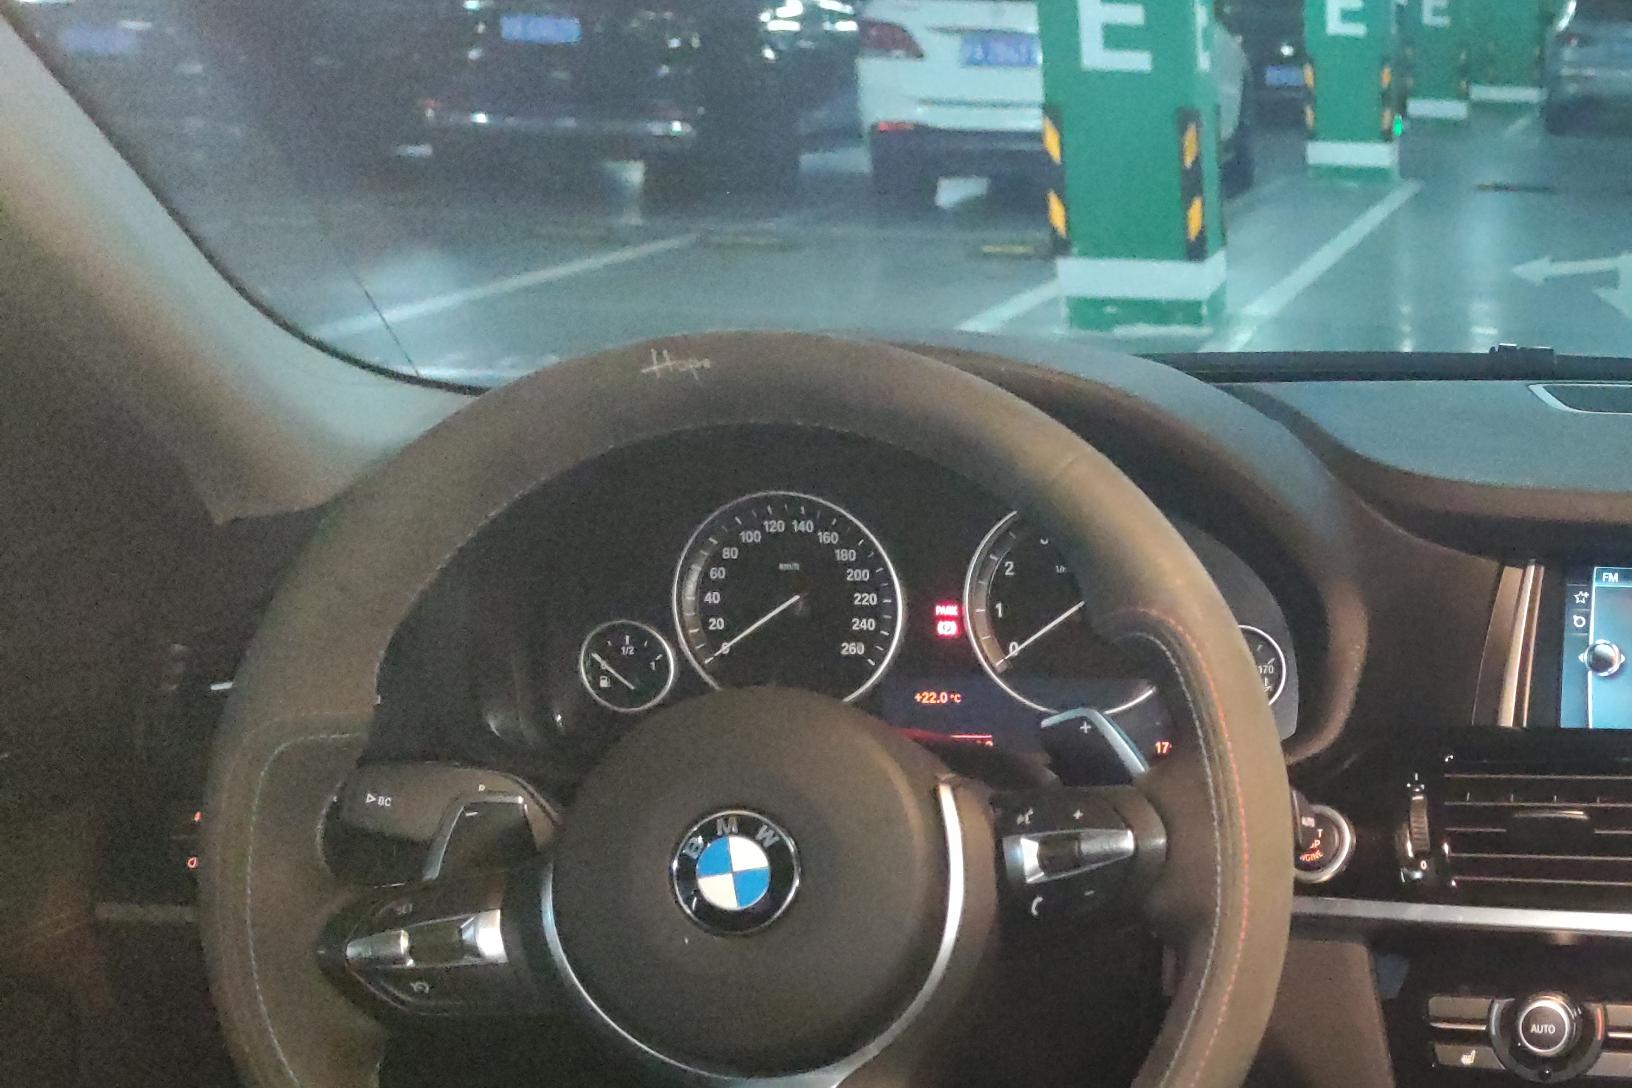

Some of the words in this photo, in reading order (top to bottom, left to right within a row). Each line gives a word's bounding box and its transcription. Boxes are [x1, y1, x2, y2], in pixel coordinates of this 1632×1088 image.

[763, 520, 785, 532] 120
[792, 520, 814, 532] 140
[740, 530, 761, 543] 100
[818, 531, 839, 544] 160
[722, 547, 738, 559] 80
[835, 549, 856, 561] 180
[709, 567, 725, 579] 60
[1004, 561, 1015, 575] 2
[846, 569, 869, 581] 200
[1602, 573, 1619, 583] FM
[704, 592, 720, 604] 40
[854, 593, 877, 606] 220
[995, 602, 1003, 617] 1
[709, 617, 725, 630] 20
[852, 618, 875, 631] 240
[621, 646, 635, 656] 1/2
[841, 642, 864, 655] 260
[1257, 665, 1274, 674] 170
[914, 691, 948, 704] +22.0
[683, 817, 780, 860] BMW
[1530, 1023, 1556, 1035] AUTO
